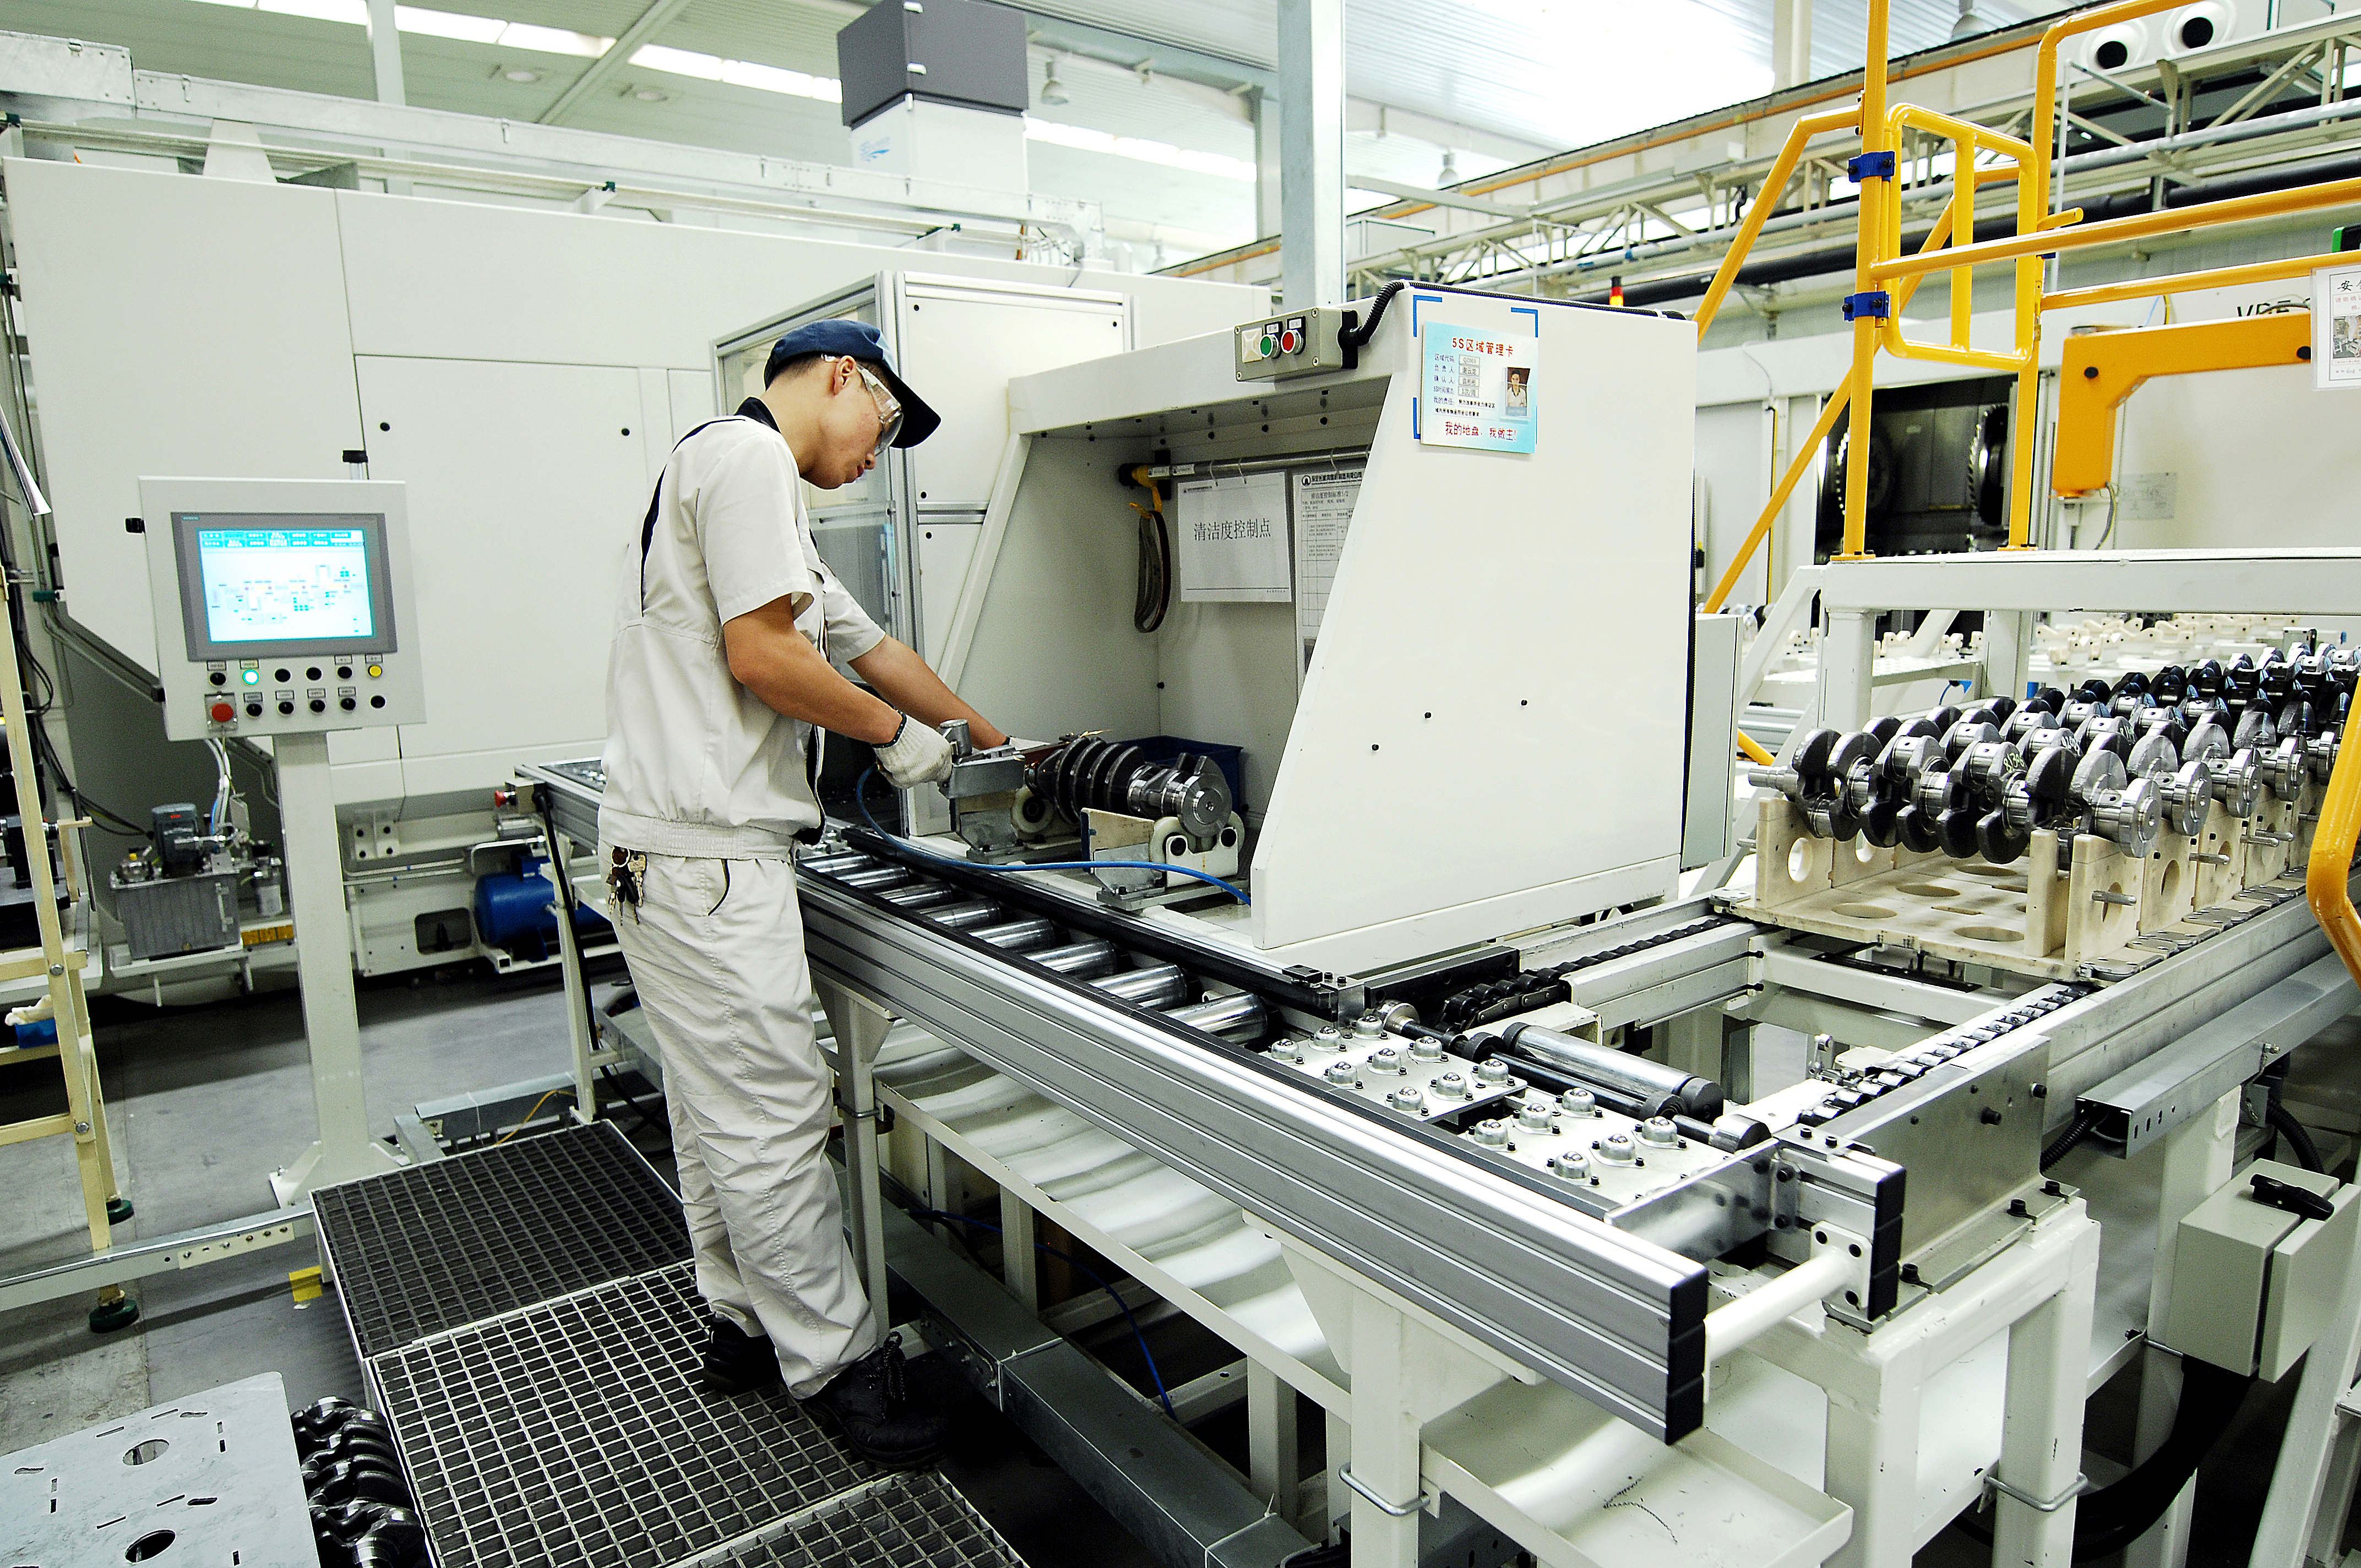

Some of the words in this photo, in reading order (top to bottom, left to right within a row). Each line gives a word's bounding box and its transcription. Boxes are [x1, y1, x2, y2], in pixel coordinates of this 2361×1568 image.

[1452, 337, 1514, 357] 5S区域管理卡
[1193, 518, 1271, 541] 清洁度控制点
